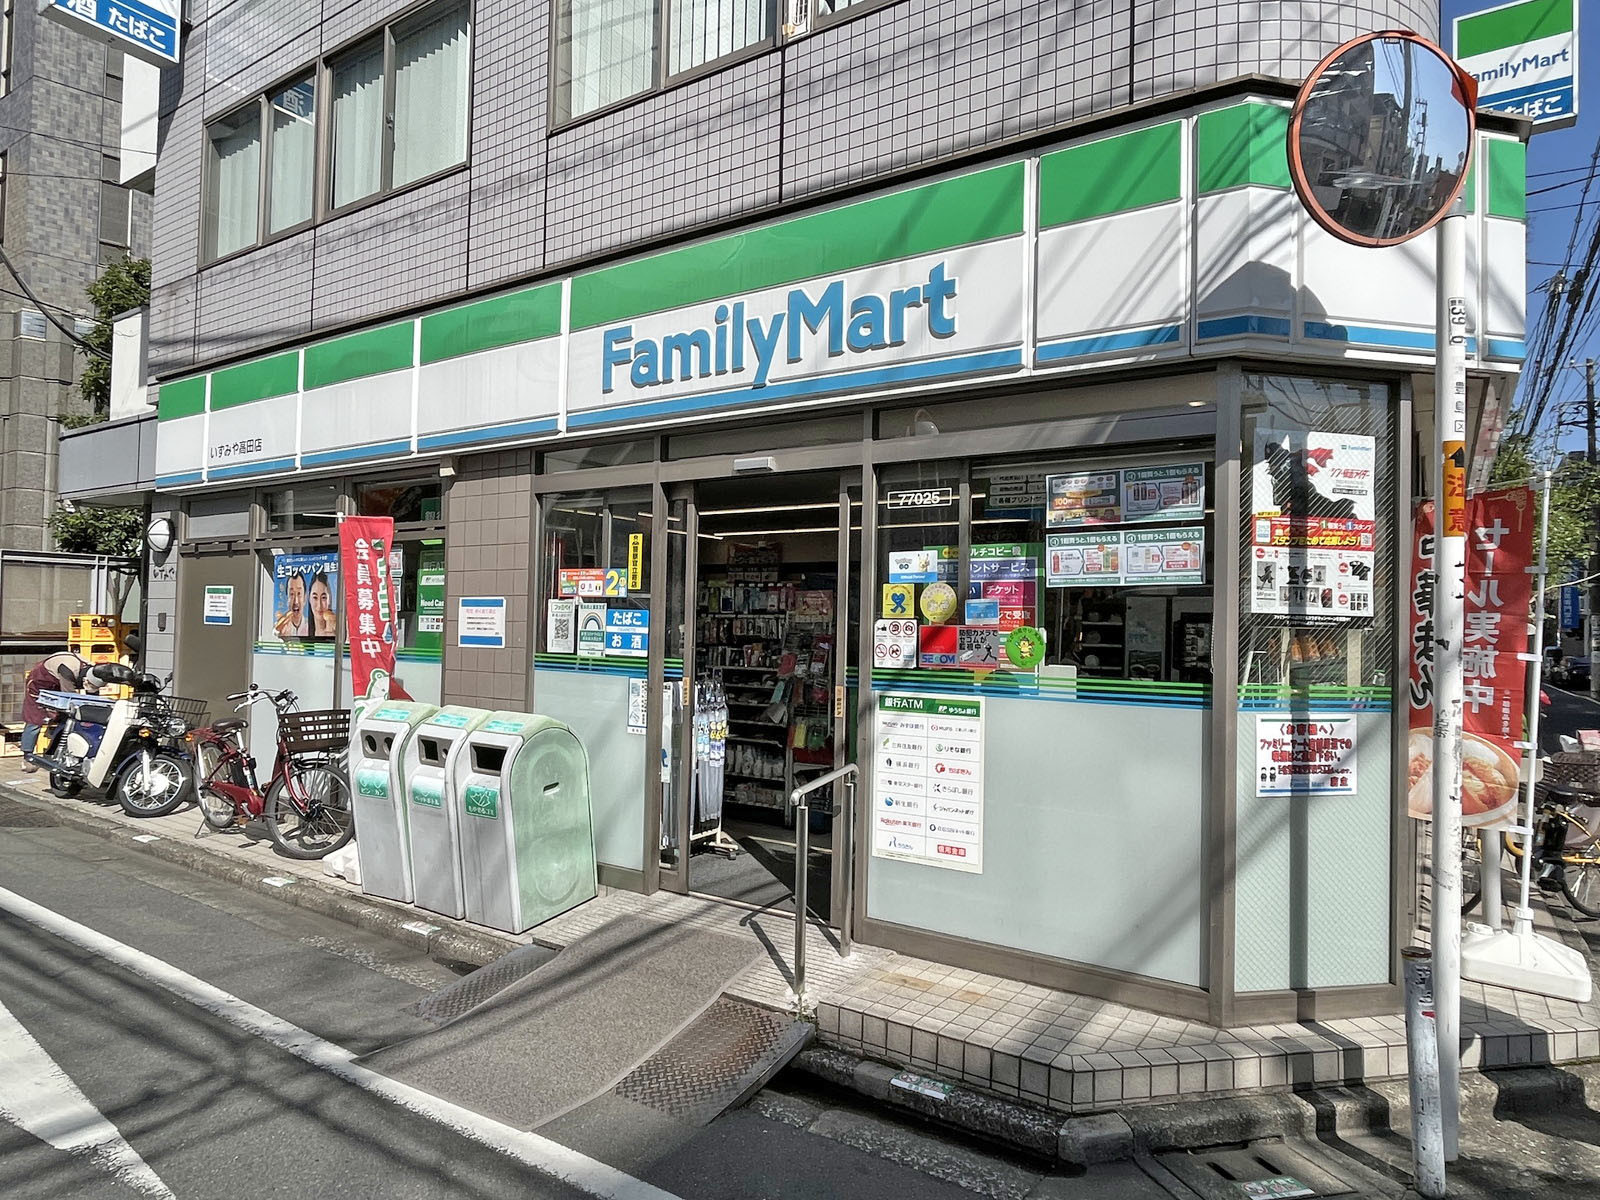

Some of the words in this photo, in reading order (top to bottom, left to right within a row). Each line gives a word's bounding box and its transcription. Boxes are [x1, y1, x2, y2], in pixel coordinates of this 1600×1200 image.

[107, 6, 167, 50] たばこ
[1467, 48, 1569, 83] amilyMart
[602, 261, 957, 389] FamilyMart
[897, 491, 940, 506] 77025
[605, 570, 619, 596] 2
[986, 585, 1019, 595] チケット
[612, 611, 642, 626] たばこ
[611, 633, 642, 649] お酒
[921, 654, 955, 664] SECOM
[884, 697, 923, 710] 銀行ATM
